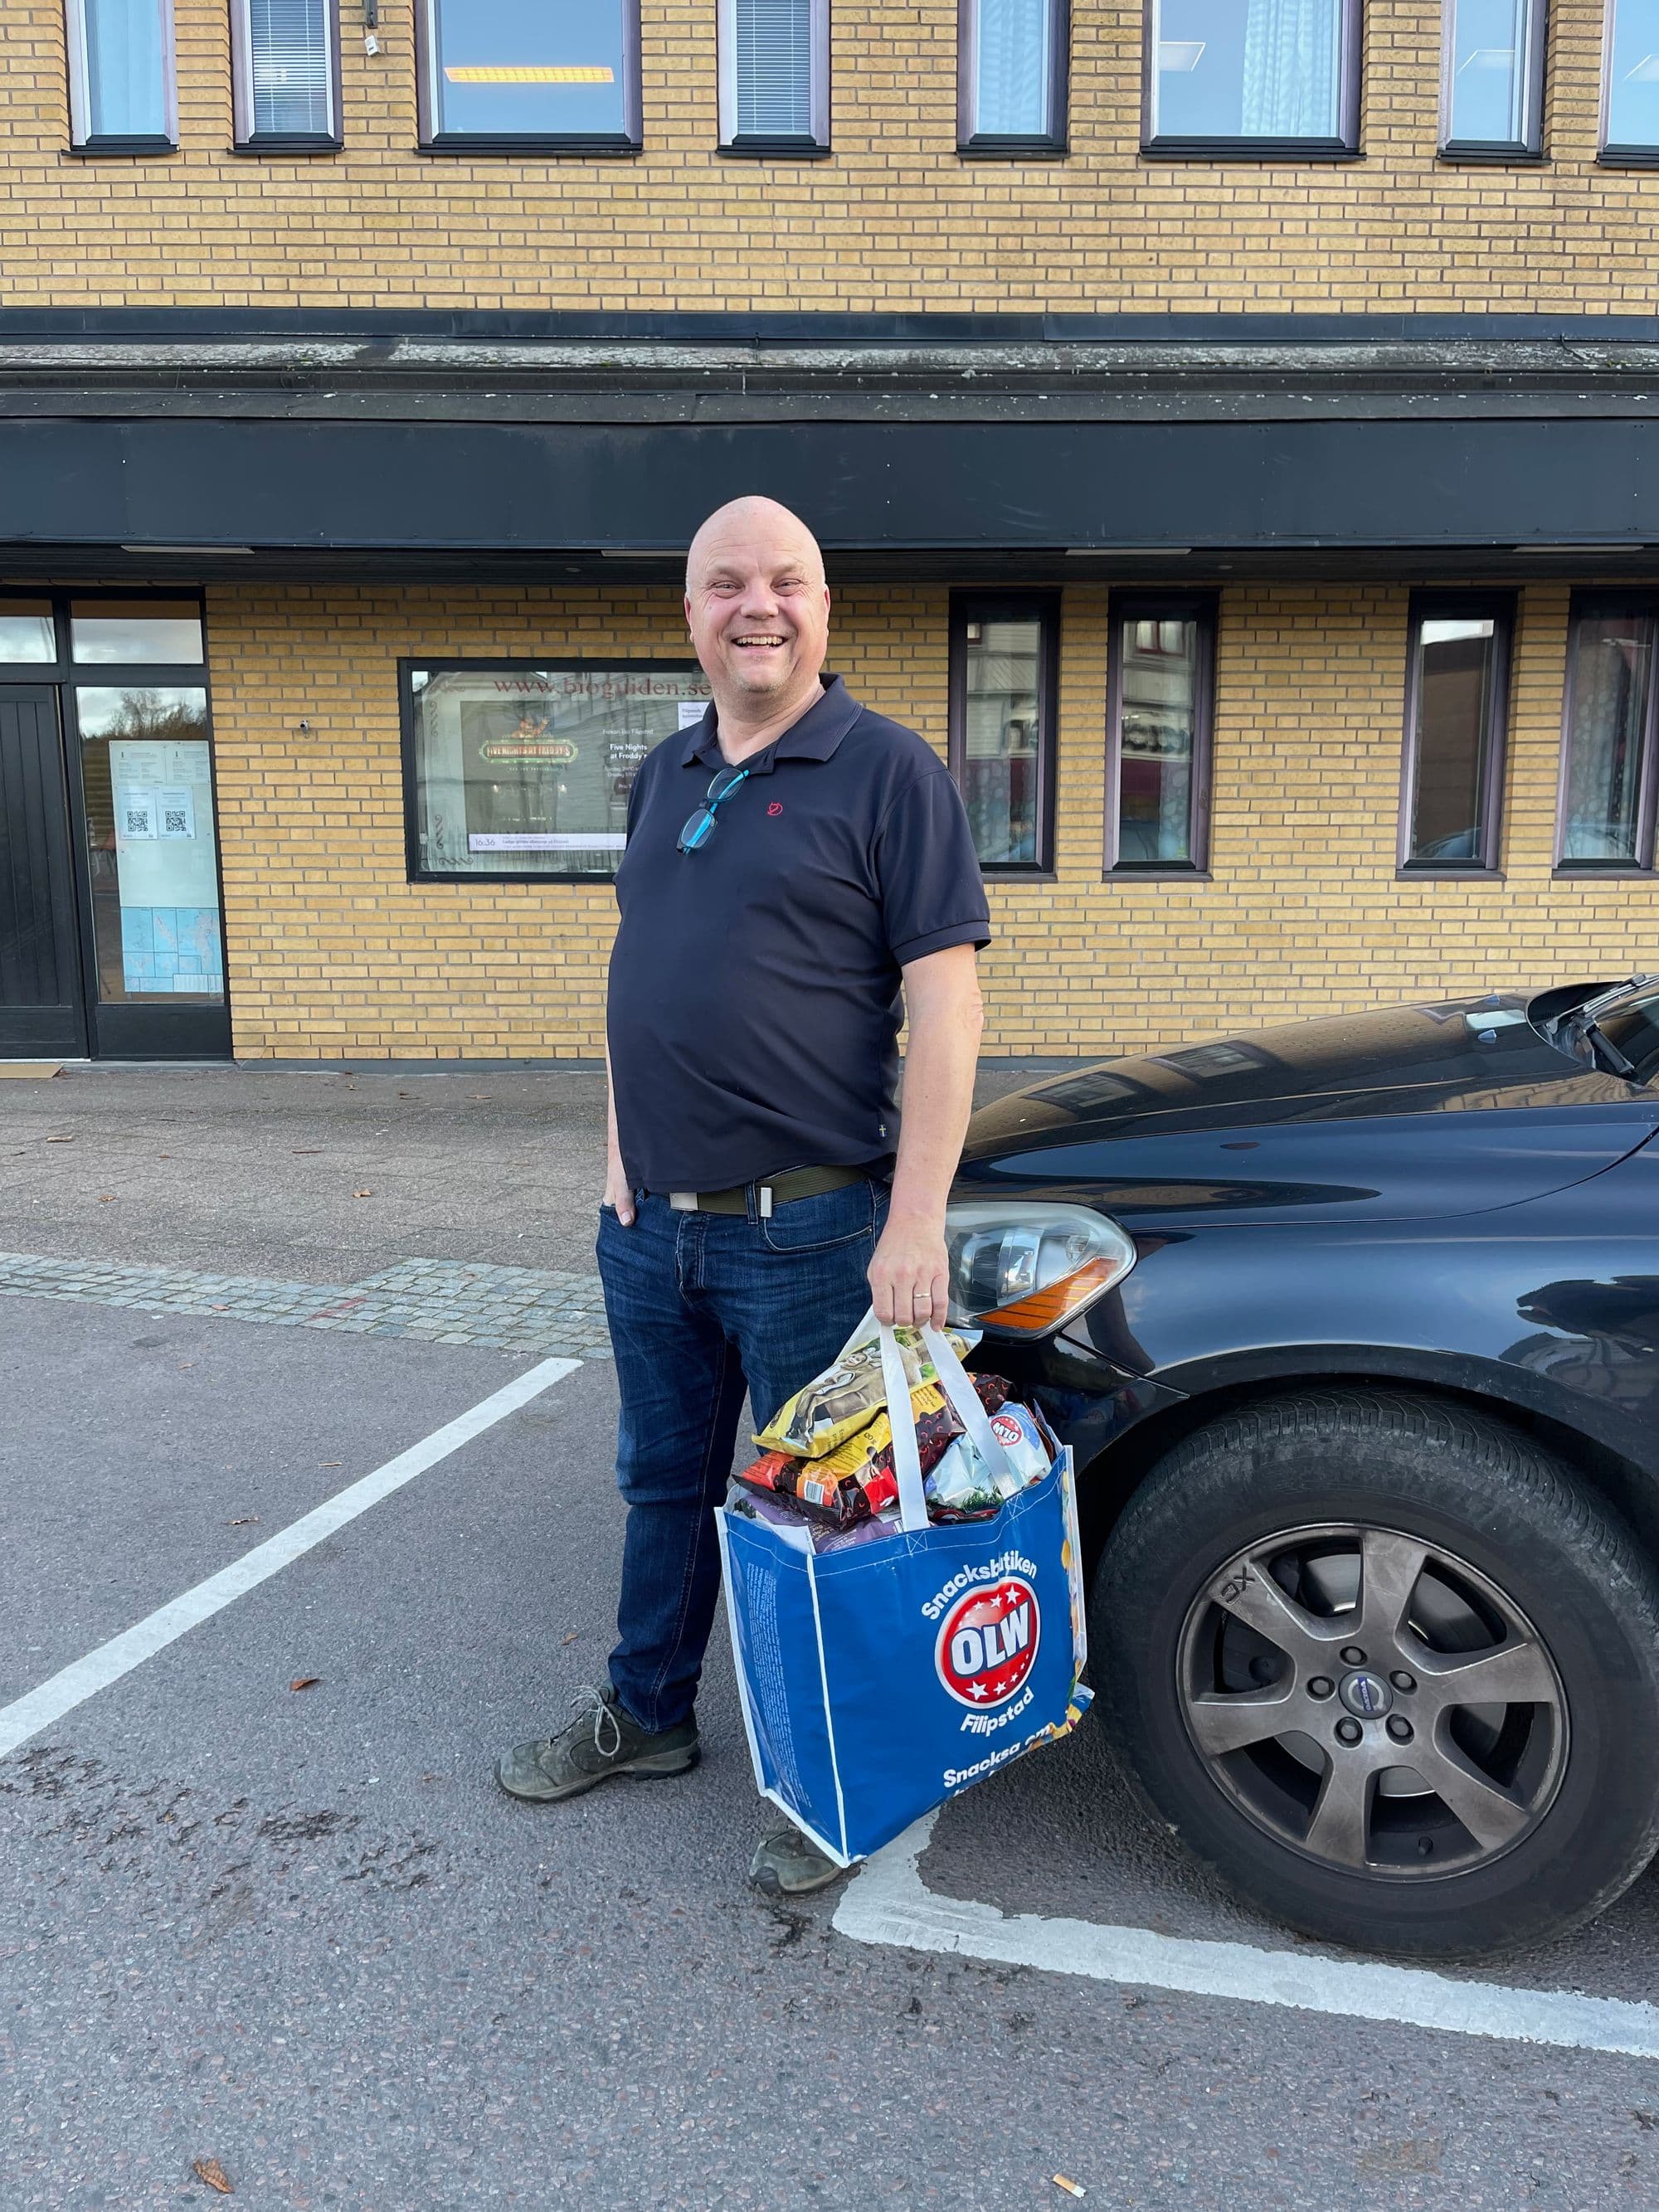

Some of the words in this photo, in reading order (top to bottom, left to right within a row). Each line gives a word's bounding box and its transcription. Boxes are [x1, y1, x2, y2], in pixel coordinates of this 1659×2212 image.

[625, 743, 648, 751] Nights
[951, 1601, 1029, 1675] OLW
[960, 1686, 1034, 1738] Filipstad
[1360, 1680, 1371, 1711] VOLVO
[943, 1742, 1021, 1788] Snacksa
